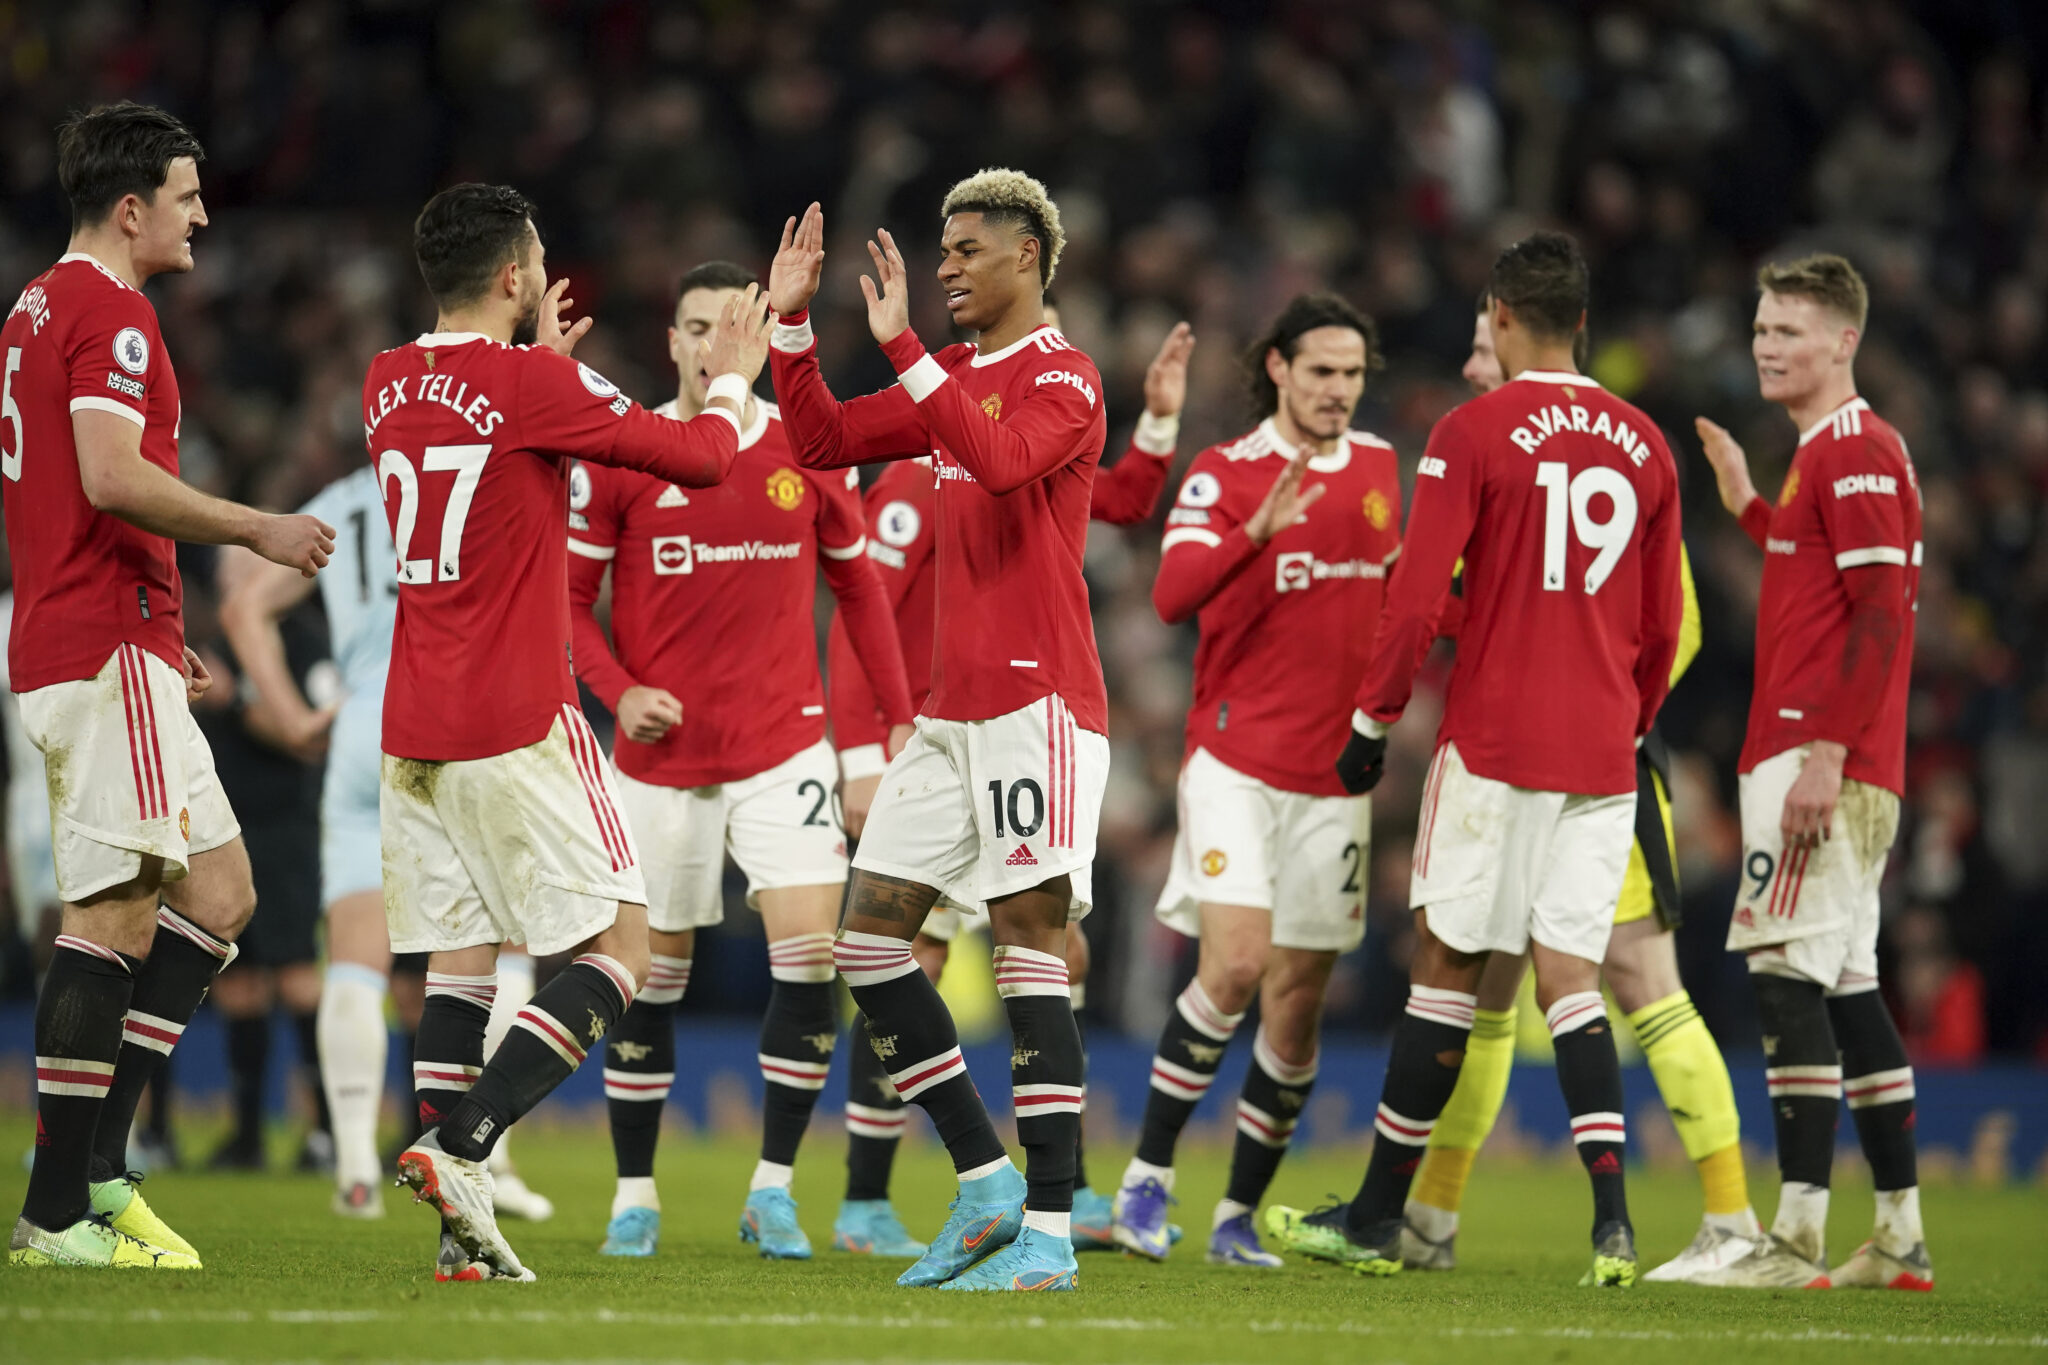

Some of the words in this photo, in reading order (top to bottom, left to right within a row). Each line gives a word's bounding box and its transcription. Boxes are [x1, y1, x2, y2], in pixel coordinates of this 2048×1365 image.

[108, 371, 123, 383] No
[1, 346, 23, 483] 5
[366, 376, 409, 449] ALEX
[417, 373, 504, 437] TELLES
[1510, 404, 1651, 468] R.VARANE
[378, 444, 493, 585] 27
[1833, 473, 1899, 500] KOHLER
[692, 540, 802, 563] TeamViewer
[1535, 461, 1638, 596] 19
[988, 778, 1044, 839] 10
[1005, 857, 1039, 866] adidas
[1747, 851, 1774, 901] 9
